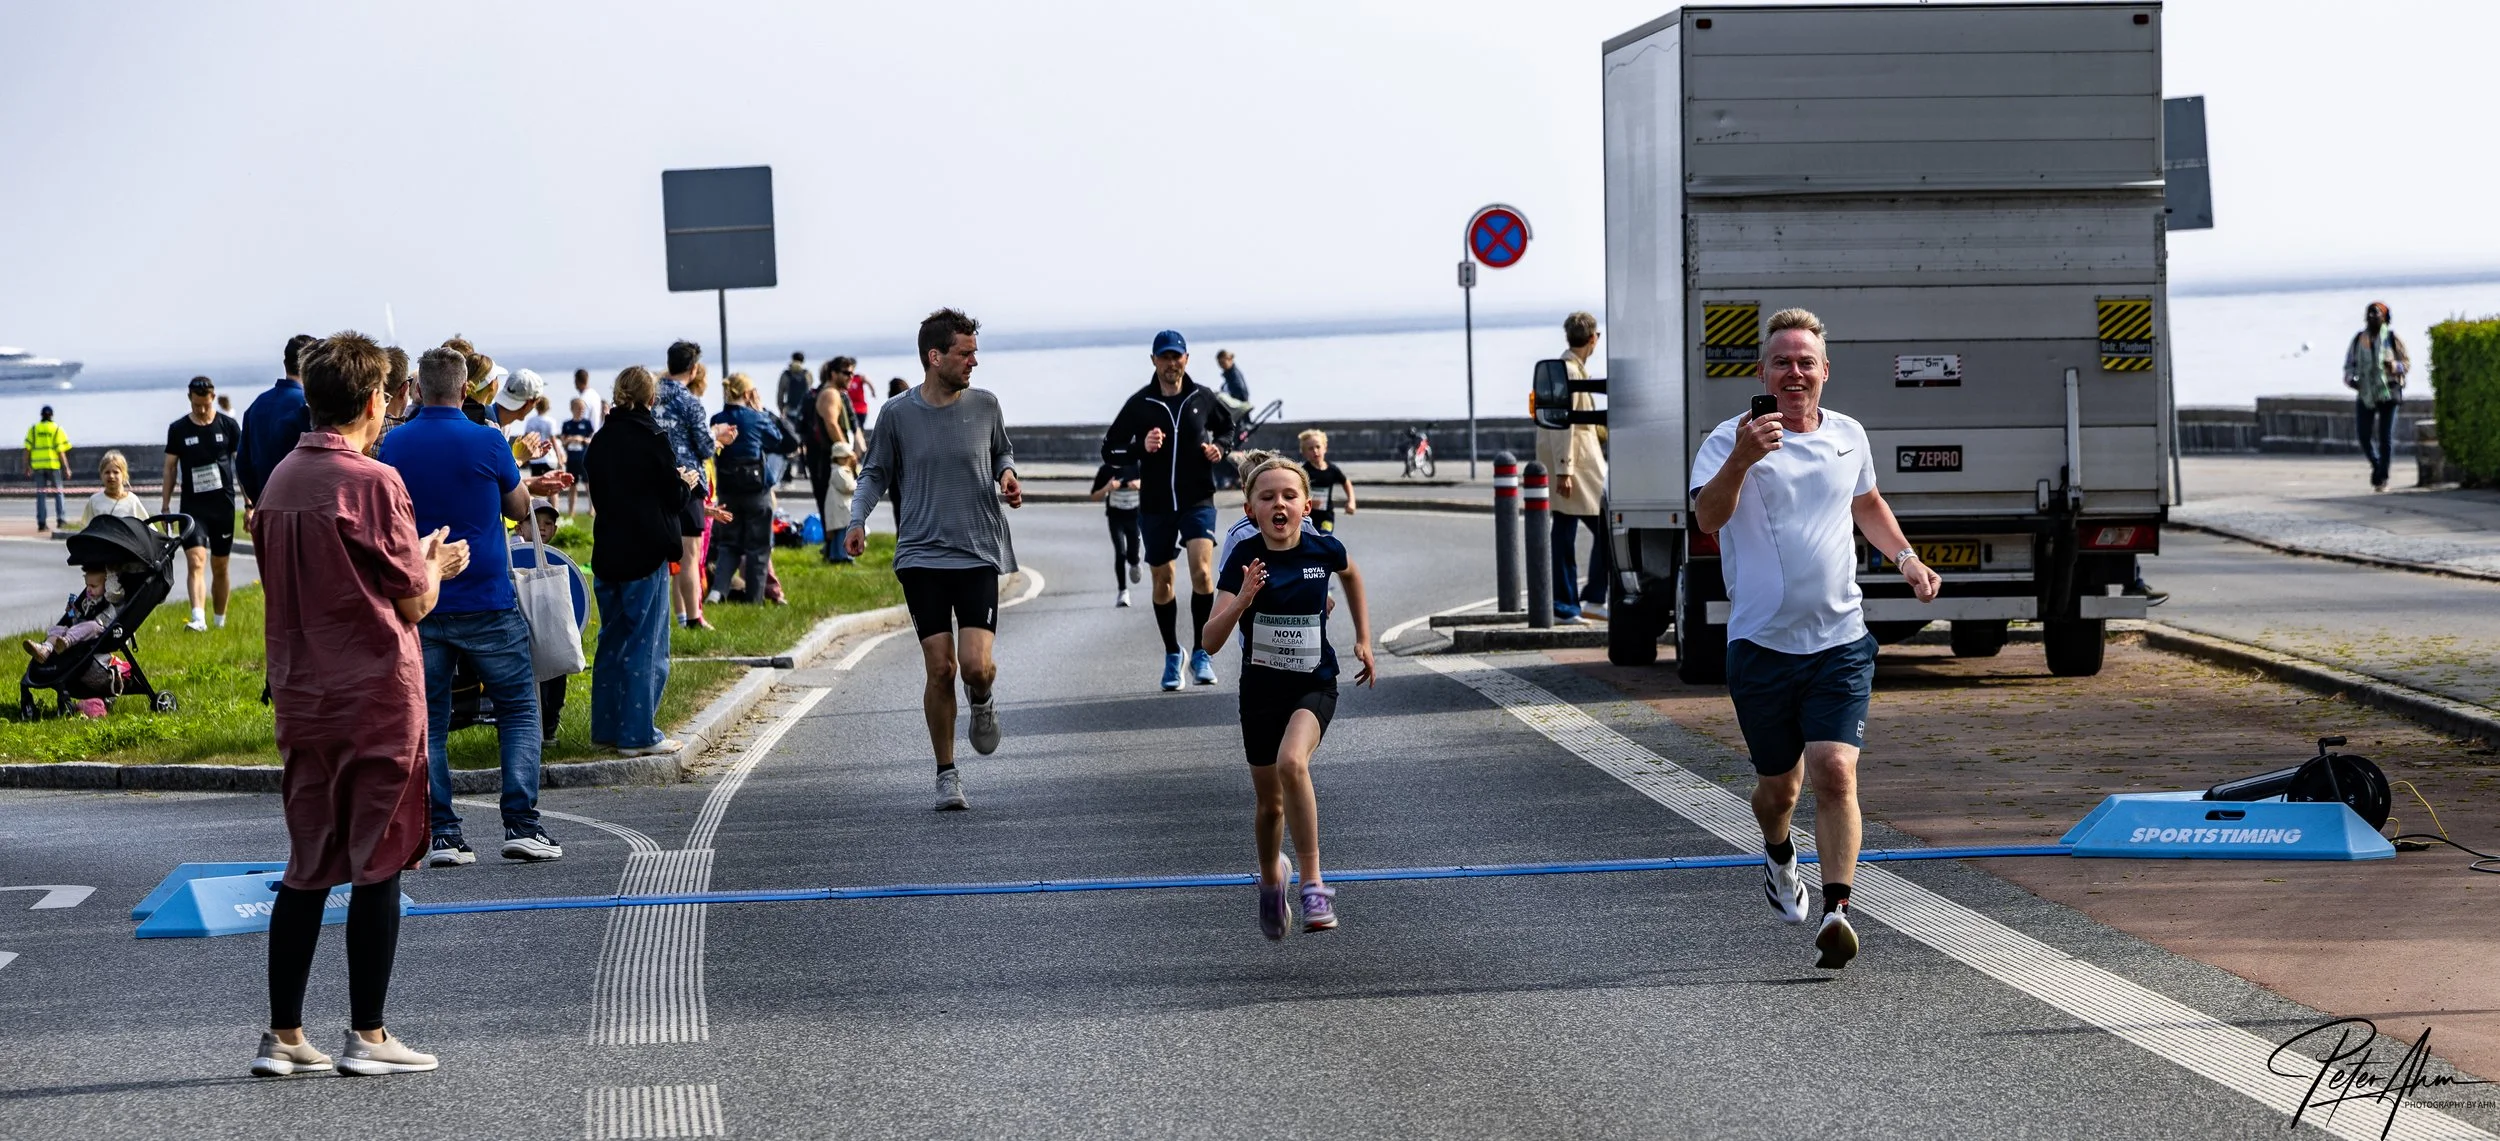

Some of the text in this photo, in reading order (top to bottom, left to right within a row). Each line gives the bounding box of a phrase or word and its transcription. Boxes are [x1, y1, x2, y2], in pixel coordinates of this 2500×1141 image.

[1918, 451, 1960, 467] ZEPRO
[1260, 615, 1310, 625] STRANDVEJEN 5K
[1274, 630, 1302, 638] NOVA
[1278, 647, 1296, 656] 201
[2129, 827, 2302, 844] SPORTSTIMING
